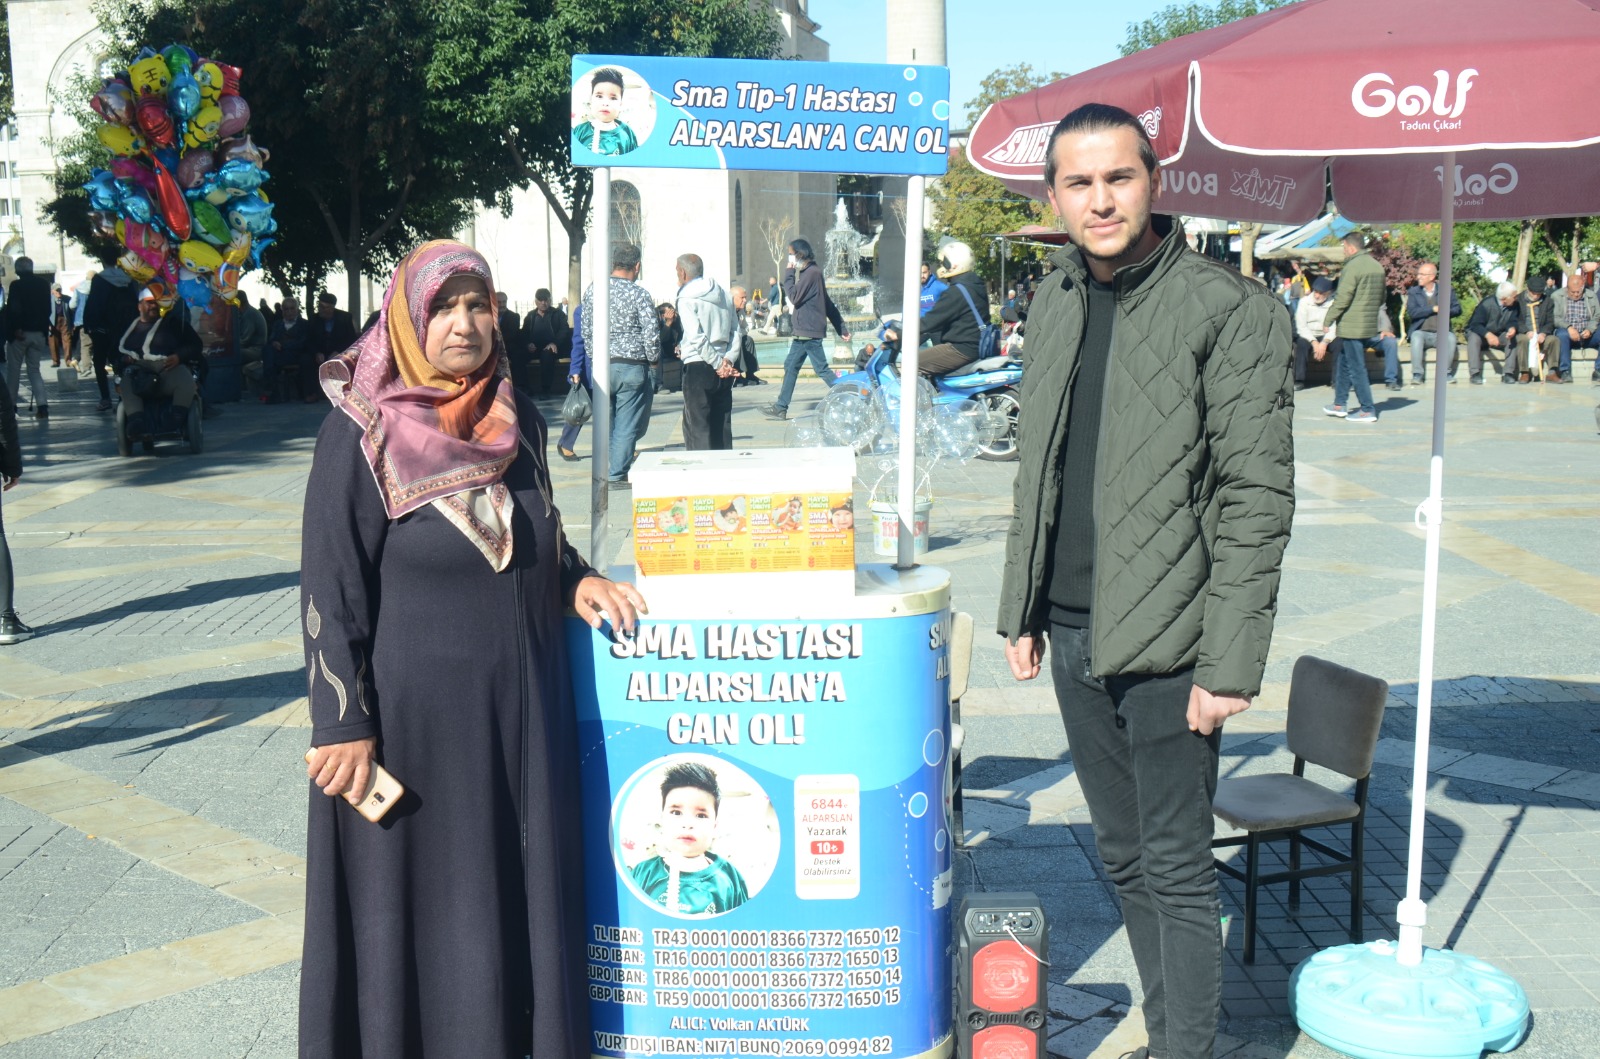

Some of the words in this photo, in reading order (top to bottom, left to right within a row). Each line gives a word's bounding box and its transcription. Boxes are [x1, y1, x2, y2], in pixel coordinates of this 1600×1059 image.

[671, 80, 729, 109] Sma
[735, 82, 797, 112] Tip-1
[803, 84, 897, 114] Hastası
[1351, 68, 1479, 118] Golf
[670, 119, 847, 151] ALPARSLAN'A
[854, 126, 907, 154] CAN
[914, 126, 947, 154] OL
[610, 624, 697, 660] SMA
[705, 624, 863, 660] HASTASI
[626, 671, 847, 703] ALPARSLAN'A
[667, 713, 740, 746] CAN
[747, 714, 806, 745] OL!
[802, 814, 853, 823] ALPARSLAN
[807, 826, 847, 836] Yazarak
[803, 867, 852, 876] Olabilirsiniz
[813, 858, 841, 866] Destek
[594, 926, 607, 941] TL
[609, 927, 641, 943] IBAN:
[654, 930, 688, 945] TR43
[691, 931, 727, 946] 0001
[731, 931, 767, 946] 0001
[770, 931, 806, 946] 8366
[810, 931, 843, 946] 7372
[847, 930, 880, 946] 1650
[884, 928, 899, 943] 12
[588, 945, 609, 960] USD
[611, 949, 643, 963] IBAN:
[655, 951, 688, 966] TR16
[691, 952, 727, 967] 0001
[730, 952, 766, 967] 0001
[769, 952, 805, 967] 8366
[809, 952, 842, 967] 7372
[846, 951, 880, 966] 1650
[884, 948, 898, 963] 13
[614, 970, 646, 984] IBAN:
[655, 971, 689, 986] TR86
[693, 972, 728, 987] 0001
[732, 973, 767, 987] 0001
[771, 973, 807, 987] 8366
[811, 973, 844, 987] 7372
[848, 971, 881, 986] 1650
[885, 968, 900, 984] 14
[590, 985, 611, 1001] GBP
[614, 988, 646, 1004] IBAN:
[656, 991, 689, 1006] TR59
[693, 992, 728, 1007] 0001
[732, 993, 767, 1007] 0001
[771, 993, 806, 1008] 8366
[810, 993, 843, 1007] 7372
[848, 991, 881, 1006] 1650
[884, 988, 899, 1004] 15
[670, 1016, 706, 1030] ALICI:
[710, 1017, 754, 1031] Volkan
[756, 1016, 810, 1031] AKTÜRK
[595, 1033, 656, 1056] YURTDIŞI
[661, 1039, 701, 1053] IBAN:
[740, 1040, 781, 1055] BUNQ
[785, 1040, 824, 1055] 2069
[828, 1039, 868, 1055] 0994
[872, 1038, 890, 1053] 82
